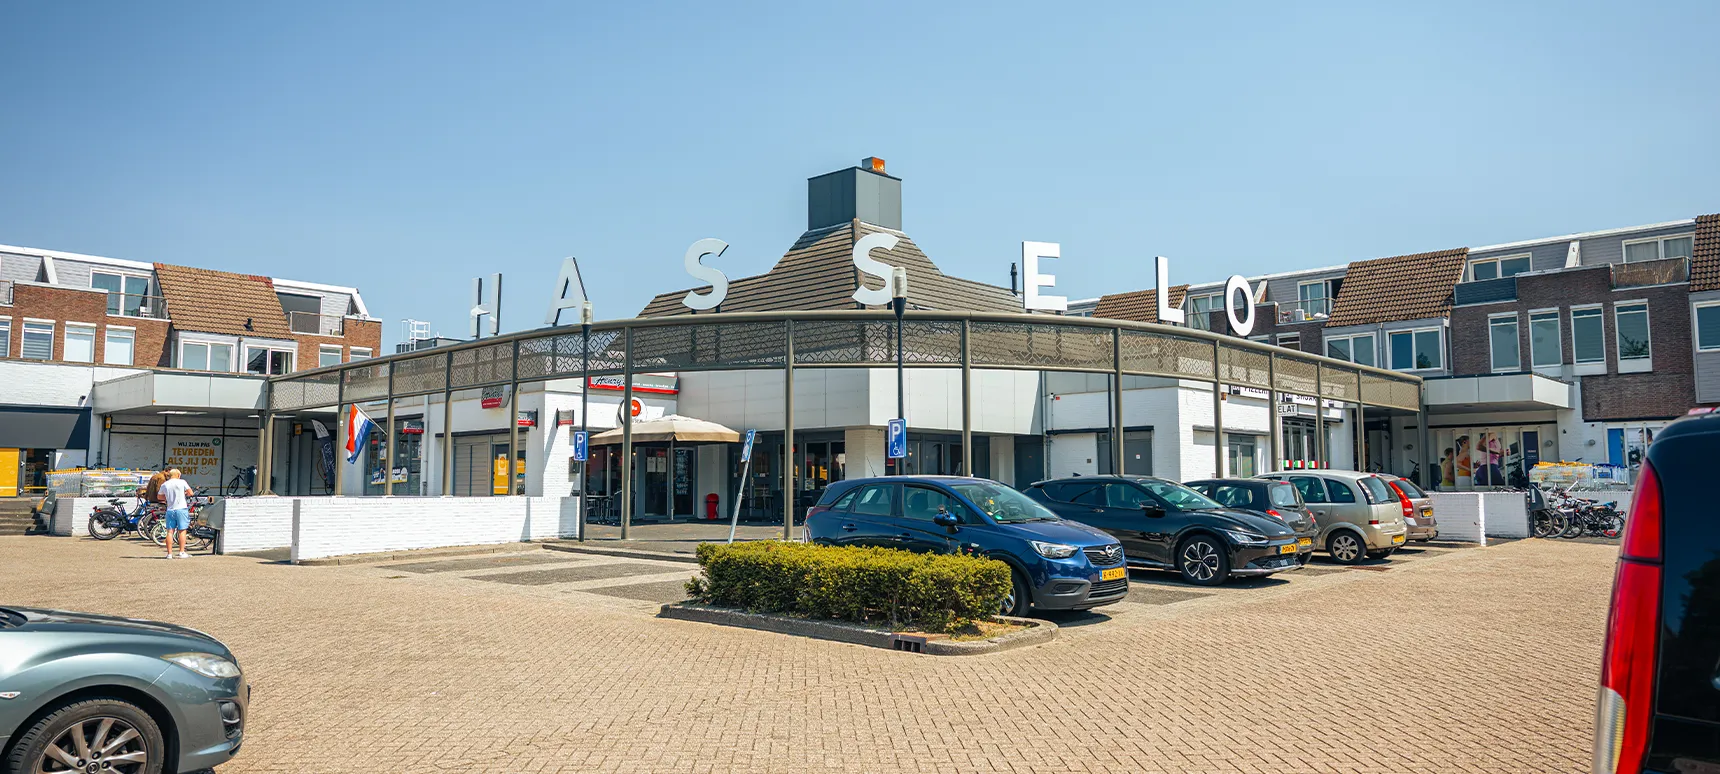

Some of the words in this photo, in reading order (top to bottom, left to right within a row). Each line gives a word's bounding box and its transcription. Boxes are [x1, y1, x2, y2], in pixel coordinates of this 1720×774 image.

[892, 423, 900, 442] P
[576, 434, 583, 448] P
[172, 448, 214, 456] TEVREDEN
[168, 457, 183, 465] ALS
[201, 458, 218, 466] DAT
